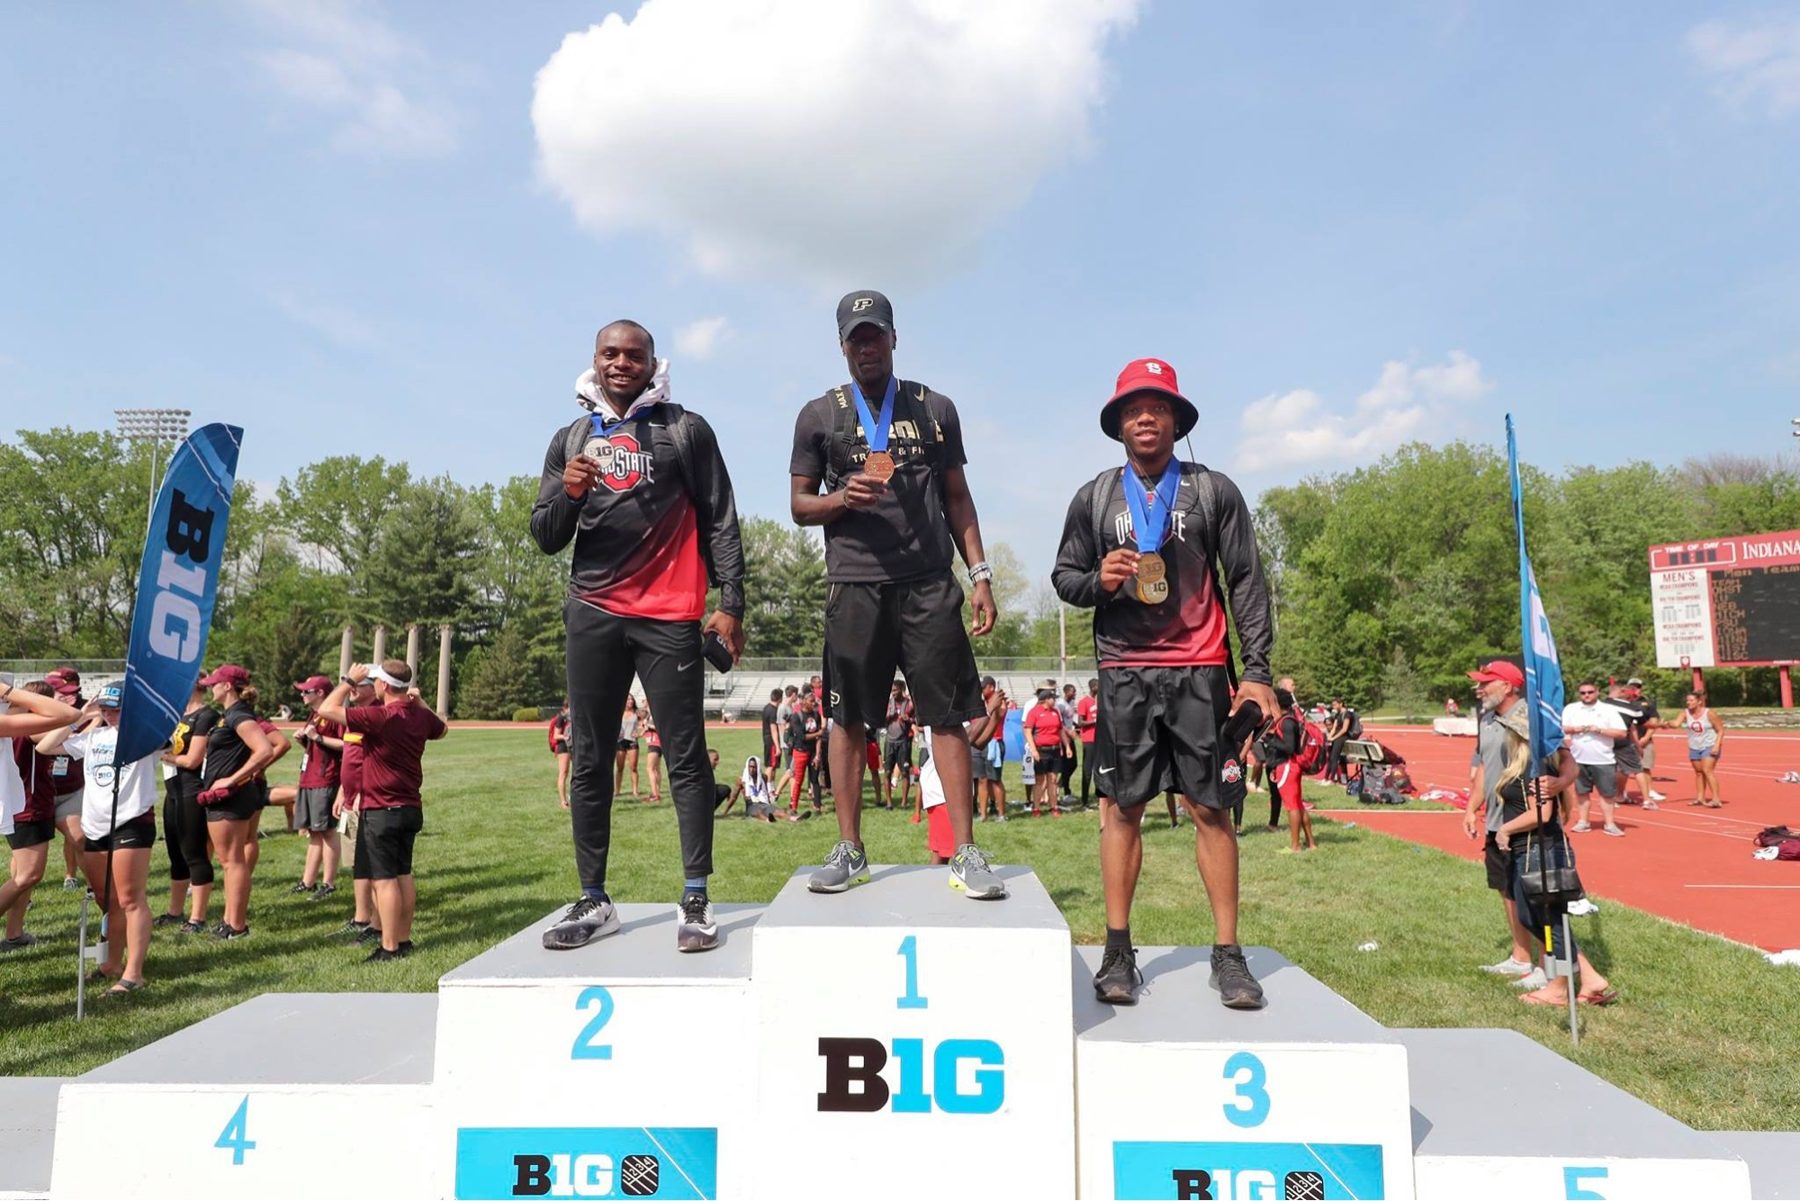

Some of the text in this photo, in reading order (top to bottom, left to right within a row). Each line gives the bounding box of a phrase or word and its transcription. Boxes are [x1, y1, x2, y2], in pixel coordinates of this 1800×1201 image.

[853, 298, 873, 311] P
[615, 448, 655, 484] STATE
[1662, 571, 1696, 582] MEN'S
[1742, 539, 1800, 559] INDIANA
[896, 935, 928, 1009] 1
[571, 985, 613, 1060] 2
[817, 1037, 1005, 1114] B1G
[1222, 1051, 1271, 1128] 3
[214, 1093, 256, 1165] 4
[512, 1154, 615, 1196] B1G
